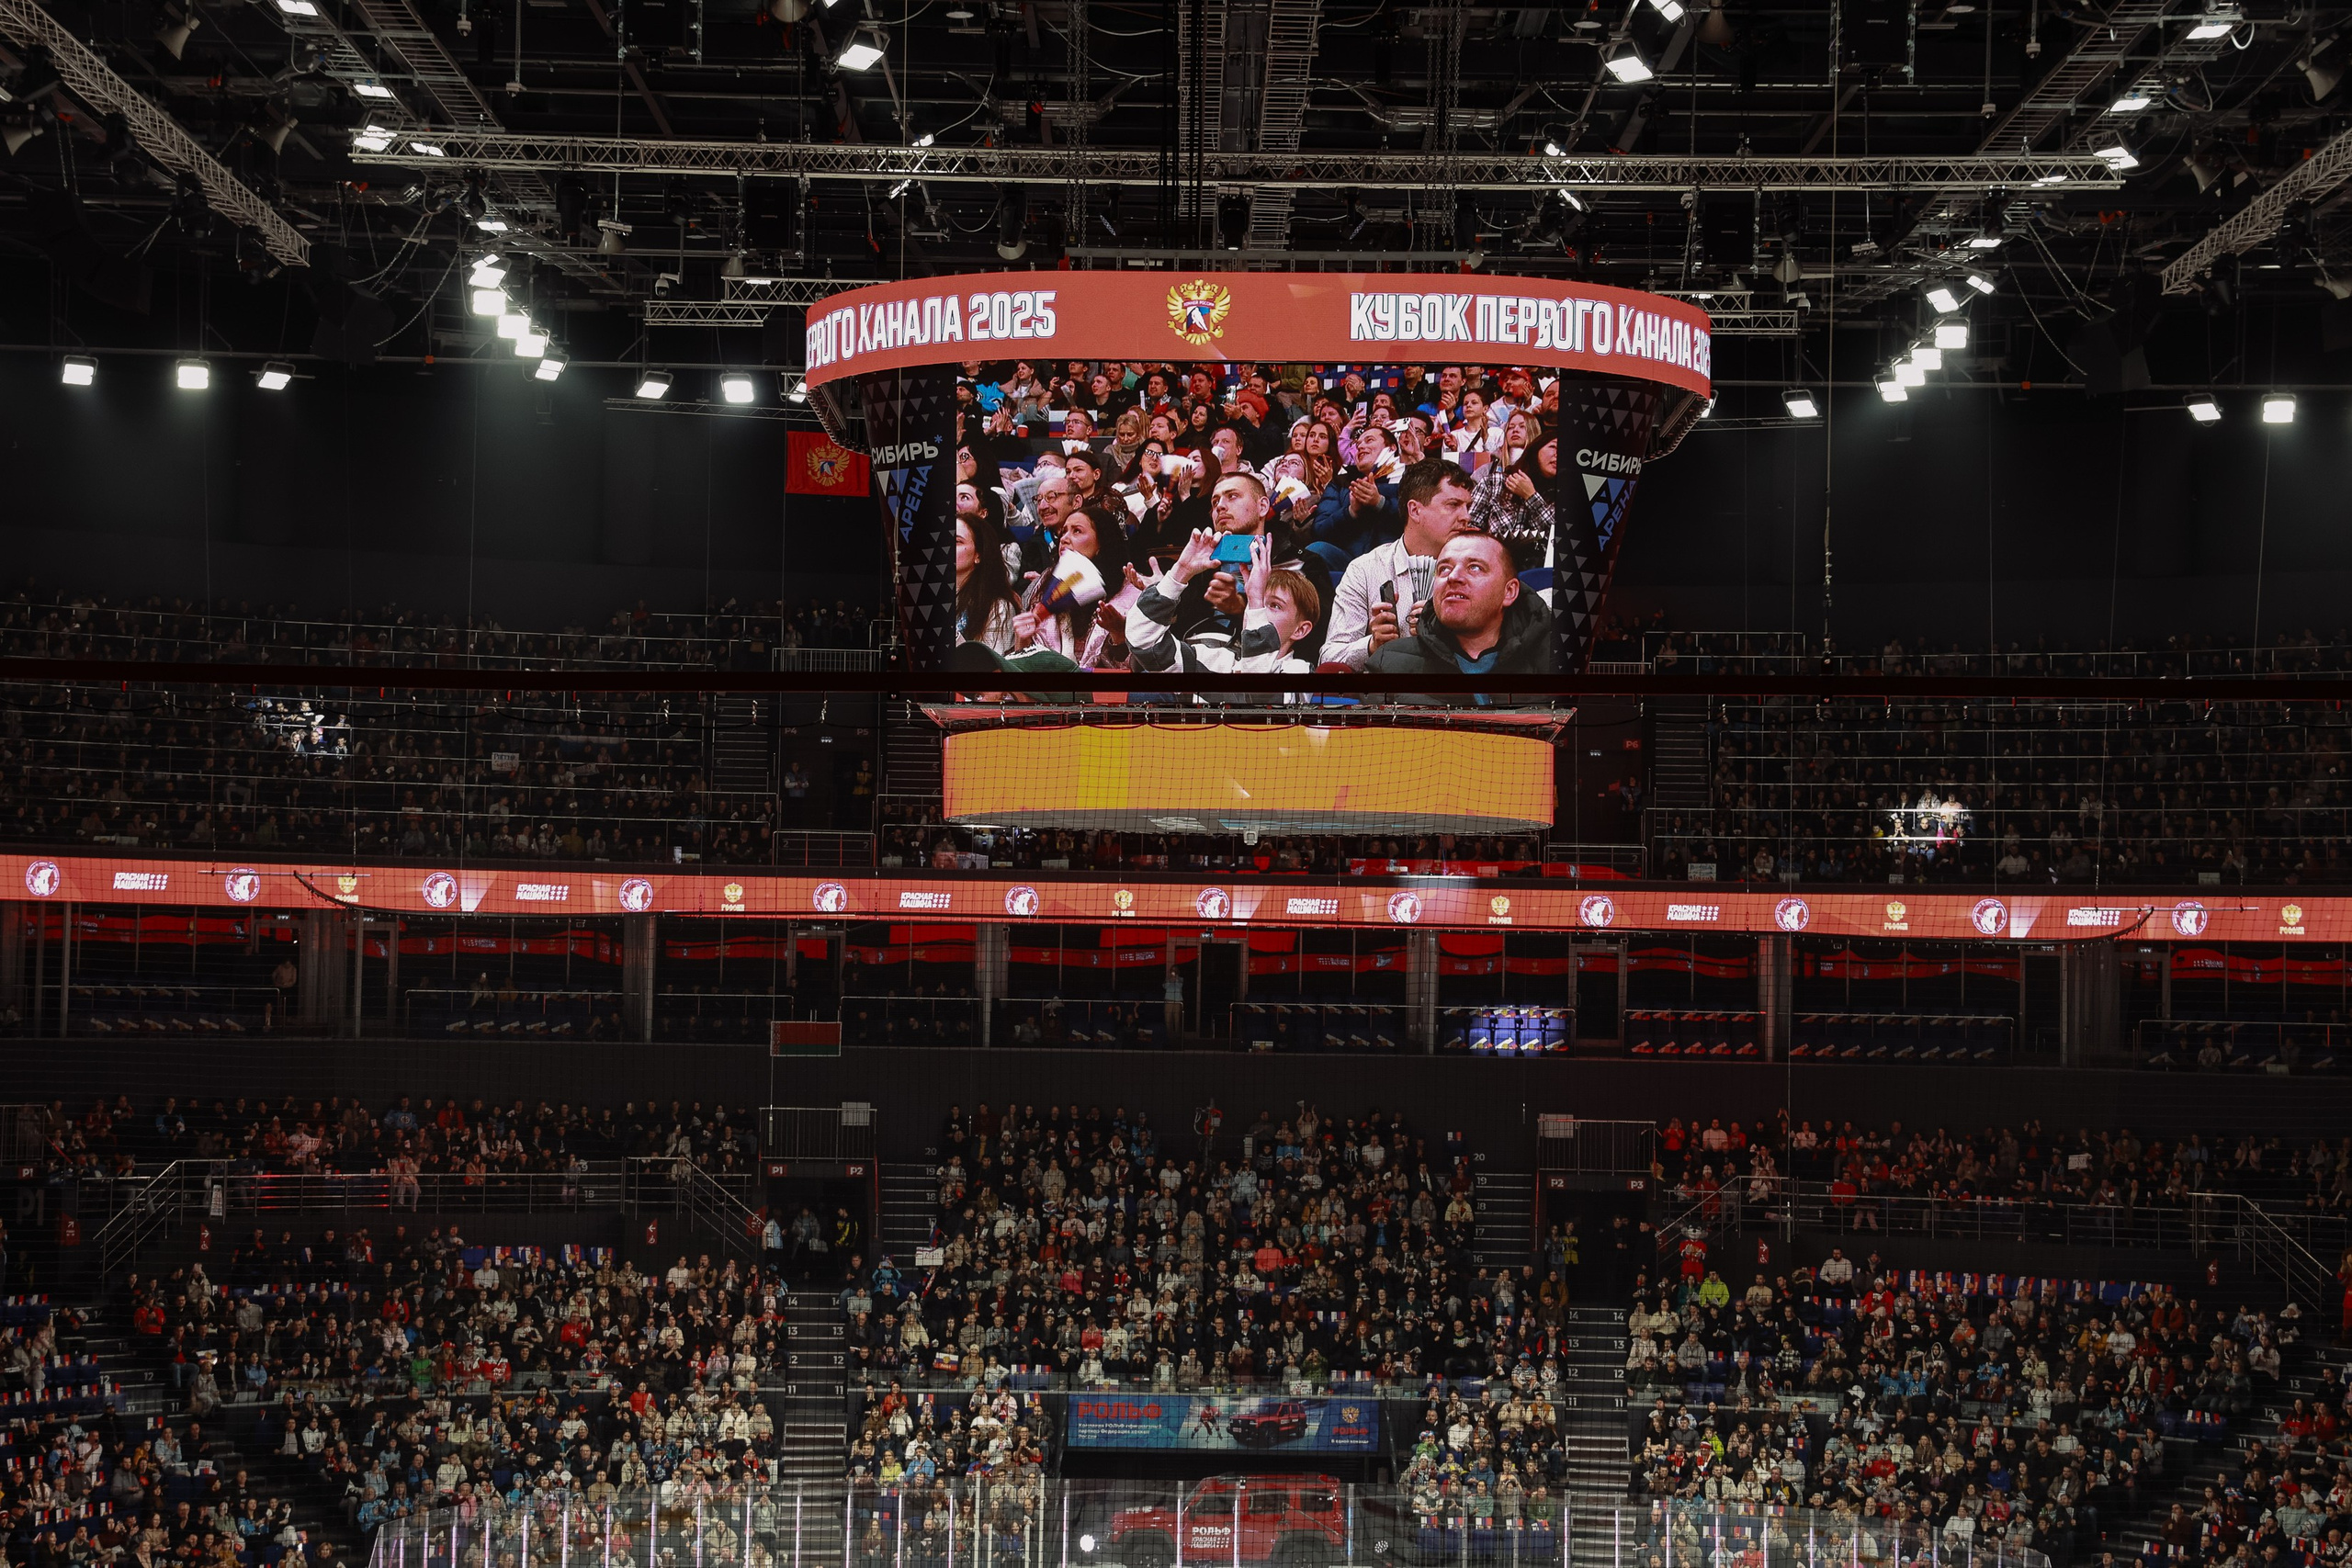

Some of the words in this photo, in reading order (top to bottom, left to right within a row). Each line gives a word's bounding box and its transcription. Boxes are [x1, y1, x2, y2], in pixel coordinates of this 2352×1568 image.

[857, 295, 963, 354] КАНАЛА
[968, 290, 1057, 340] 2025
[1350, 292, 1472, 342] КУБОК
[1475, 294, 1613, 355] ПЕРВОГО
[1615, 303, 1692, 369] КАНАЛА
[871, 441, 939, 466] СИБИРЬ
[1576, 448, 1643, 475] СИБИРЬ
[899, 465, 933, 545] АРЕНА
[1598, 479, 1637, 552] АРЕНА
[924, 1147, 937, 1156] 20
[1473, 1153, 1486, 1161] 20
[925, 1168, 935, 1176] 19
[1476, 1177, 1487, 1185] 19
[926, 1192, 936, 1201] 18
[1475, 1227, 1485, 1236] 17
[1473, 1255, 1483, 1263] 16
[787, 1297, 797, 1305] 14
[1569, 1311, 1579, 1320] 14
[1613, 1312, 1624, 1321] 14
[787, 1326, 797, 1336] 13
[832, 1326, 843, 1336] 13
[1568, 1338, 1579, 1348] 13
[1613, 1340, 1624, 1349] 13
[2315, 1350, 2326, 1360] 14
[833, 1356, 844, 1365] 12
[144, 1372, 154, 1381] 12
[1567, 1368, 1578, 1377] 12
[1613, 1369, 1624, 1379] 12
[99, 1375, 110, 1384] 12
[2290, 1379, 2301, 1389] 13
[787, 1385, 797, 1393] 11
[834, 1385, 844, 1394] 11
[1568, 1397, 1577, 1406] 11
[1614, 1398, 1623, 1407] 11
[171, 1403, 180, 1411] 11
[1078, 1402, 1162, 1419] РОЛЬФ
[1332, 1427, 1369, 1436] РОЛЬФ
[2238, 1438, 2246, 1448] 11
[1192, 1527, 1231, 1535] РОЛЬФ
